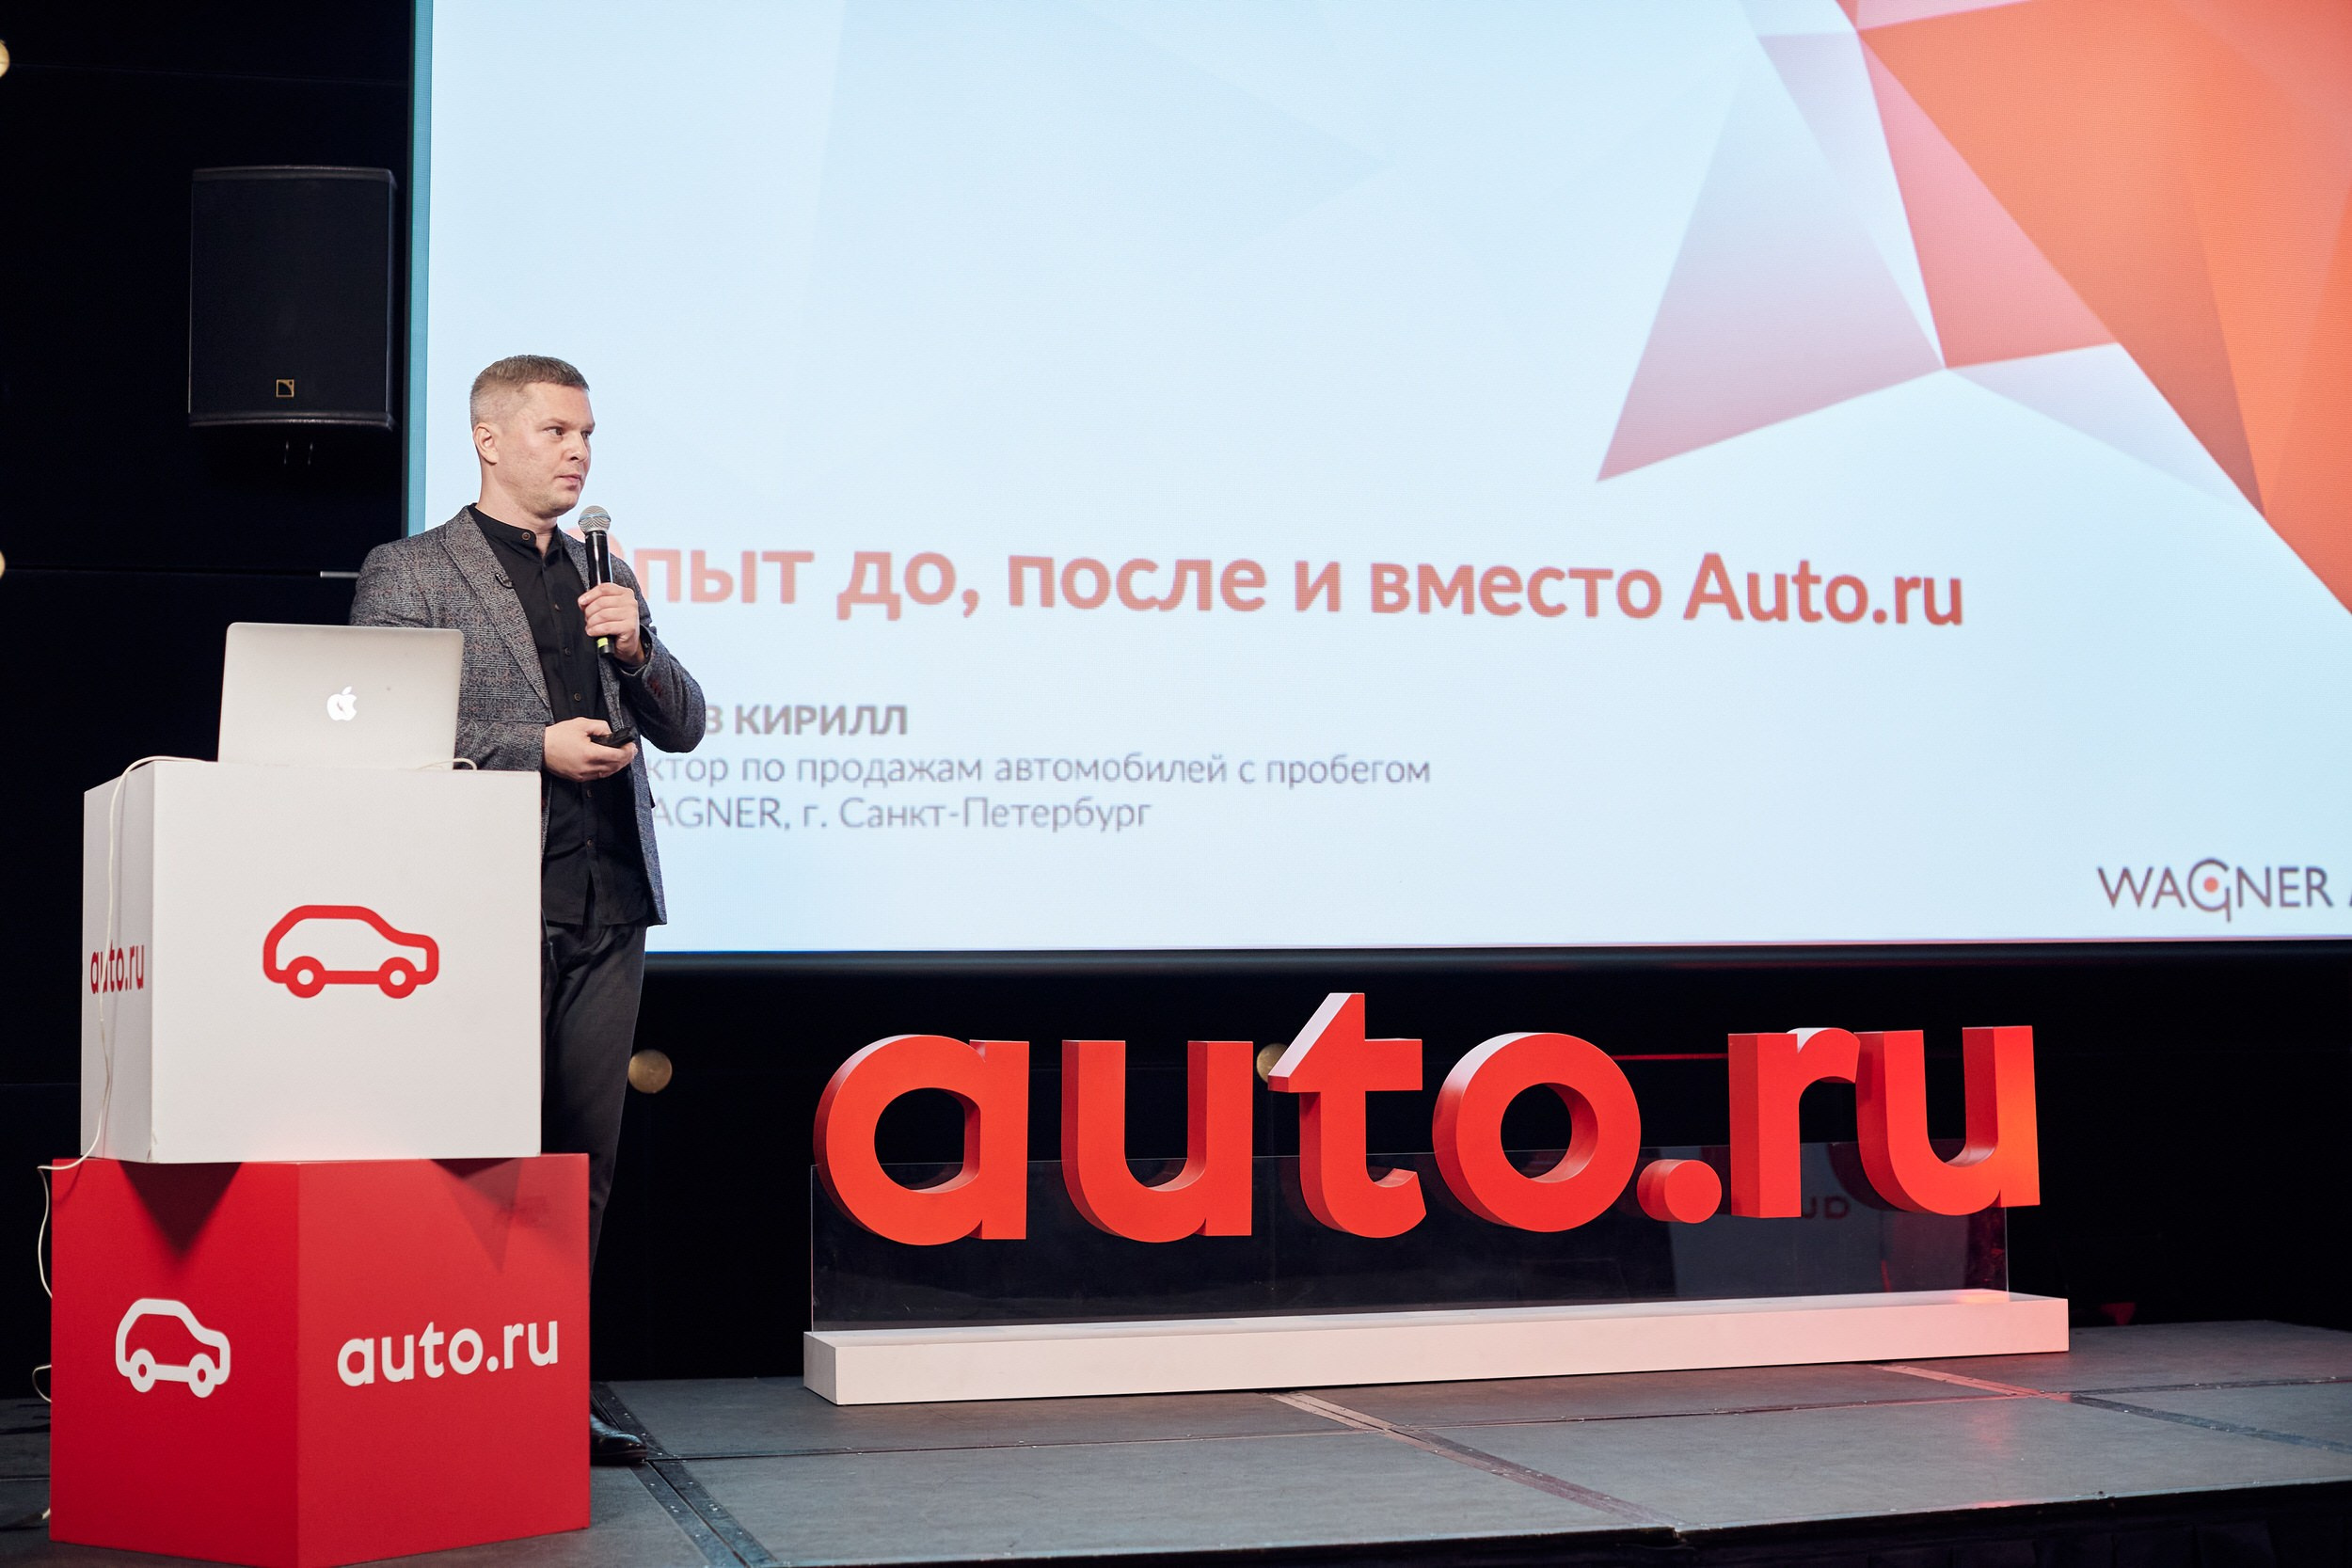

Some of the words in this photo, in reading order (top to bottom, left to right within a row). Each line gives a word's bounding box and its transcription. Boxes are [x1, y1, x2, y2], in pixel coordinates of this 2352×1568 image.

[837, 551, 980, 622] до,
[1009, 554, 1267, 612] после
[1295, 561, 1343, 613] и
[1371, 562, 1662, 621] вместо
[1683, 552, 1963, 627] Auto.ru
[735, 705, 909, 737] КИРИЛЛ
[647, 756, 729, 788] ктор
[742, 757, 787, 783] по
[798, 758, 982, 788] продажам
[994, 752, 1228, 784] автомобилей
[1238, 760, 1257, 784] с
[1267, 754, 1432, 790] пробегом
[654, 796, 791, 831] AGNER,
[803, 804, 829, 830] г.
[839, 796, 1152, 833] Санкт-Петербург
[2097, 857, 2334, 923] WAGNER
[90, 939, 145, 994] auto.ru
[813, 992, 2041, 1246] auto.ru
[337, 1320, 559, 1387] auto.ru
